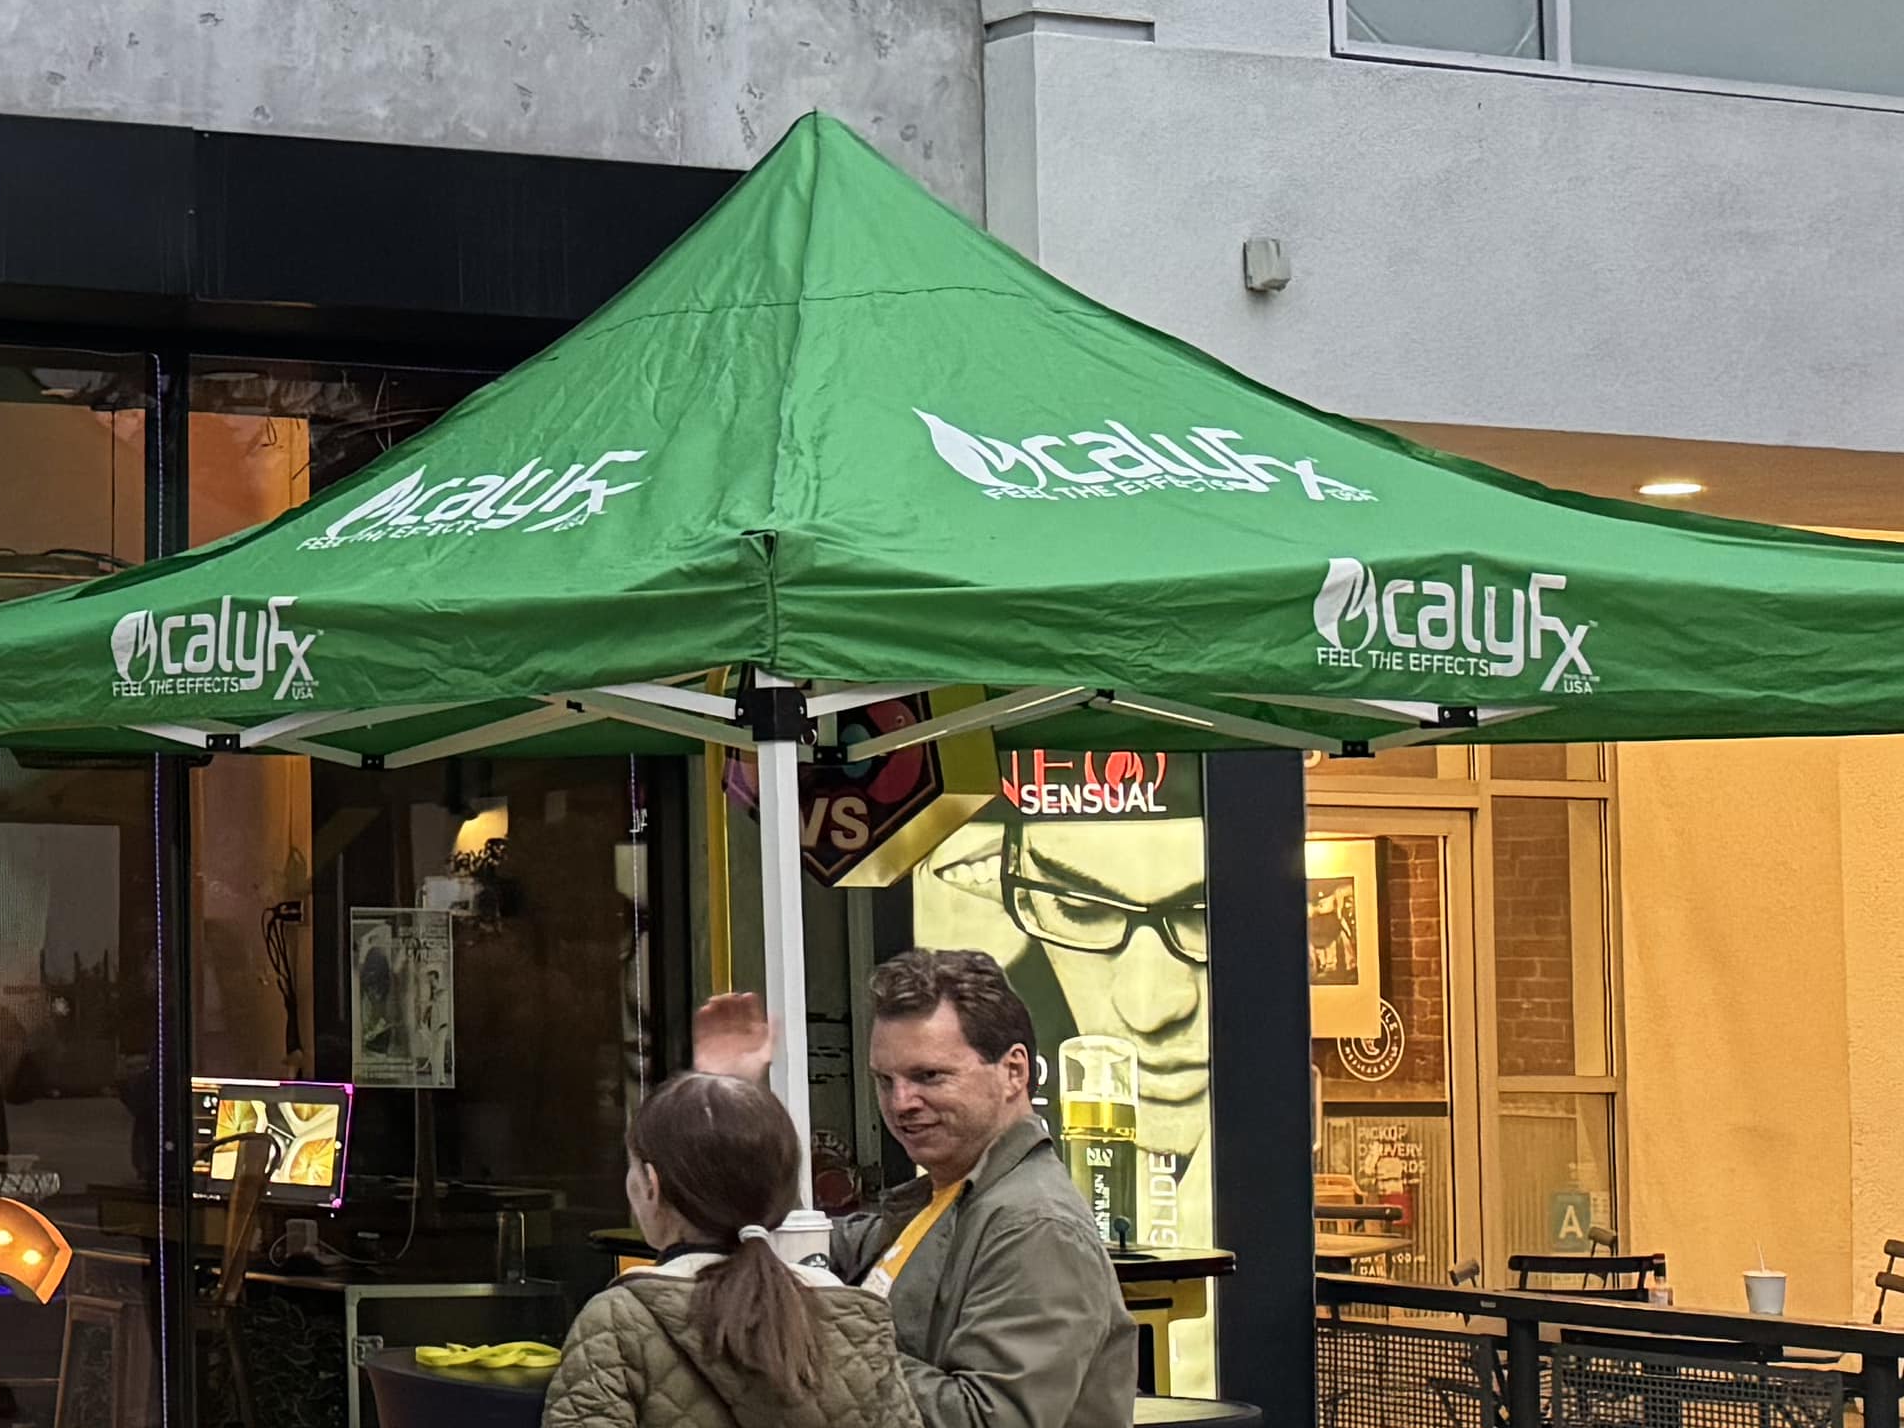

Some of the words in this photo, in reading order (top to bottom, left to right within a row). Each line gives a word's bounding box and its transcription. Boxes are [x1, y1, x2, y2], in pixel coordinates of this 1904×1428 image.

[1061, 485, 1118, 500] THE
[1316, 647, 1363, 668] FEEL
[1368, 650, 1404, 670] THE
[1409, 653, 1489, 677] EFFECTS
[1563, 680, 1593, 694] USA
[112, 680, 145, 697] FEEL
[149, 678, 174, 696] THE
[176, 676, 240, 695] EFFECTS
[292, 687, 314, 701] USA
[1020, 781, 1168, 815] SENSUAL
[1558, 1204, 1584, 1239] A
